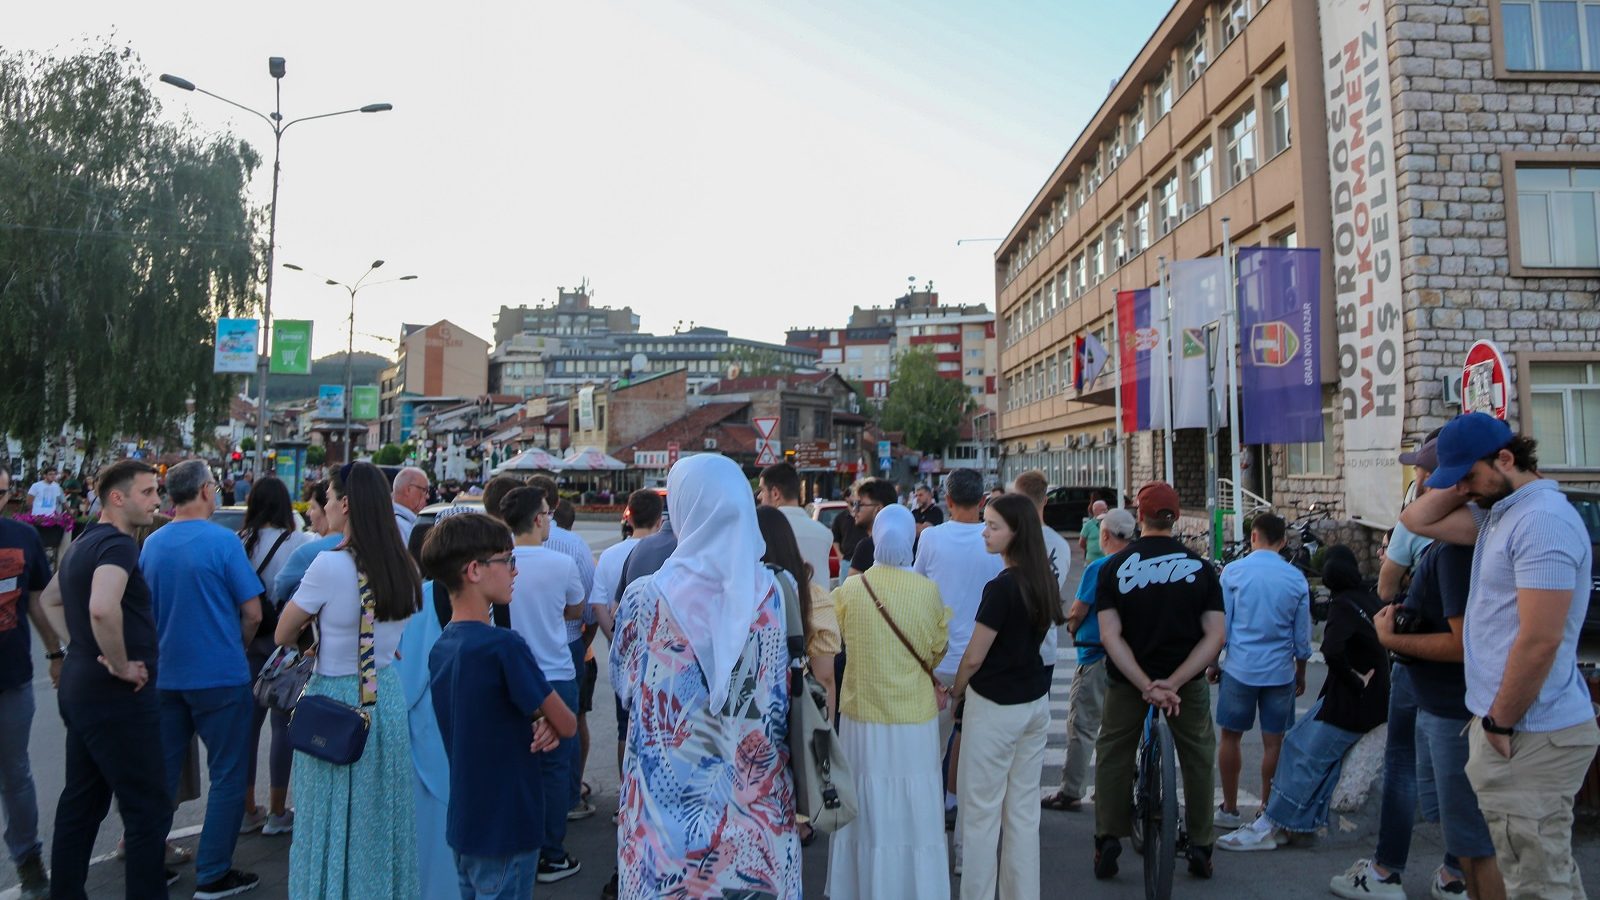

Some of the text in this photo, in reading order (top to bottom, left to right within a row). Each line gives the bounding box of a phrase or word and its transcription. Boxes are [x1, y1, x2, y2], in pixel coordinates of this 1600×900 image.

[1303, 303, 1313, 386] GRAD NOVI PAZAR
[1326, 50, 1357, 420] DOBRODOŠLI
[1343, 36, 1374, 419] WILLKOMMEN
[1361, 20, 1400, 417] HOŞ GELDINIZ
